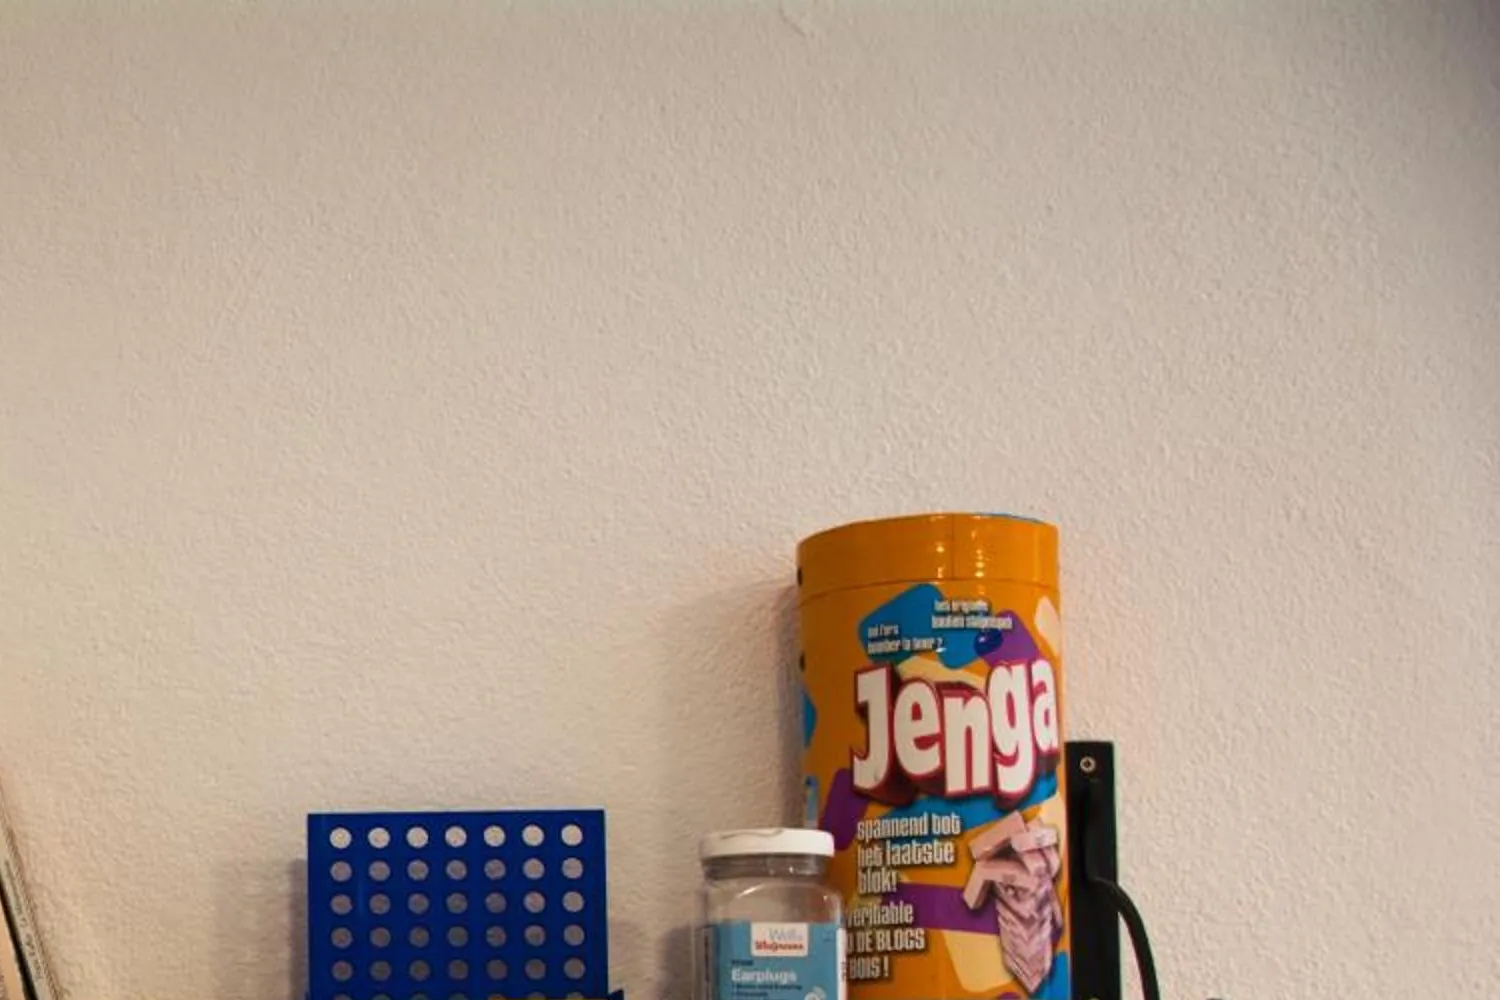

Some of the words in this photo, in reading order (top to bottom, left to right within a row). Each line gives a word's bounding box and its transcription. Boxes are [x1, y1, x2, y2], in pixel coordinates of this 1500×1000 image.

[853, 659, 1059, 797] Jenga
[857, 812, 928, 843] spannend
[931, 812, 961, 835] tot
[857, 845, 882, 867] het
[885, 840, 955, 865] laatste
[858, 868, 897, 894] blok!
[857, 930, 873, 952] DE
[876, 927, 925, 951] BLOCS
[731, 968, 798, 984] Earplugs
